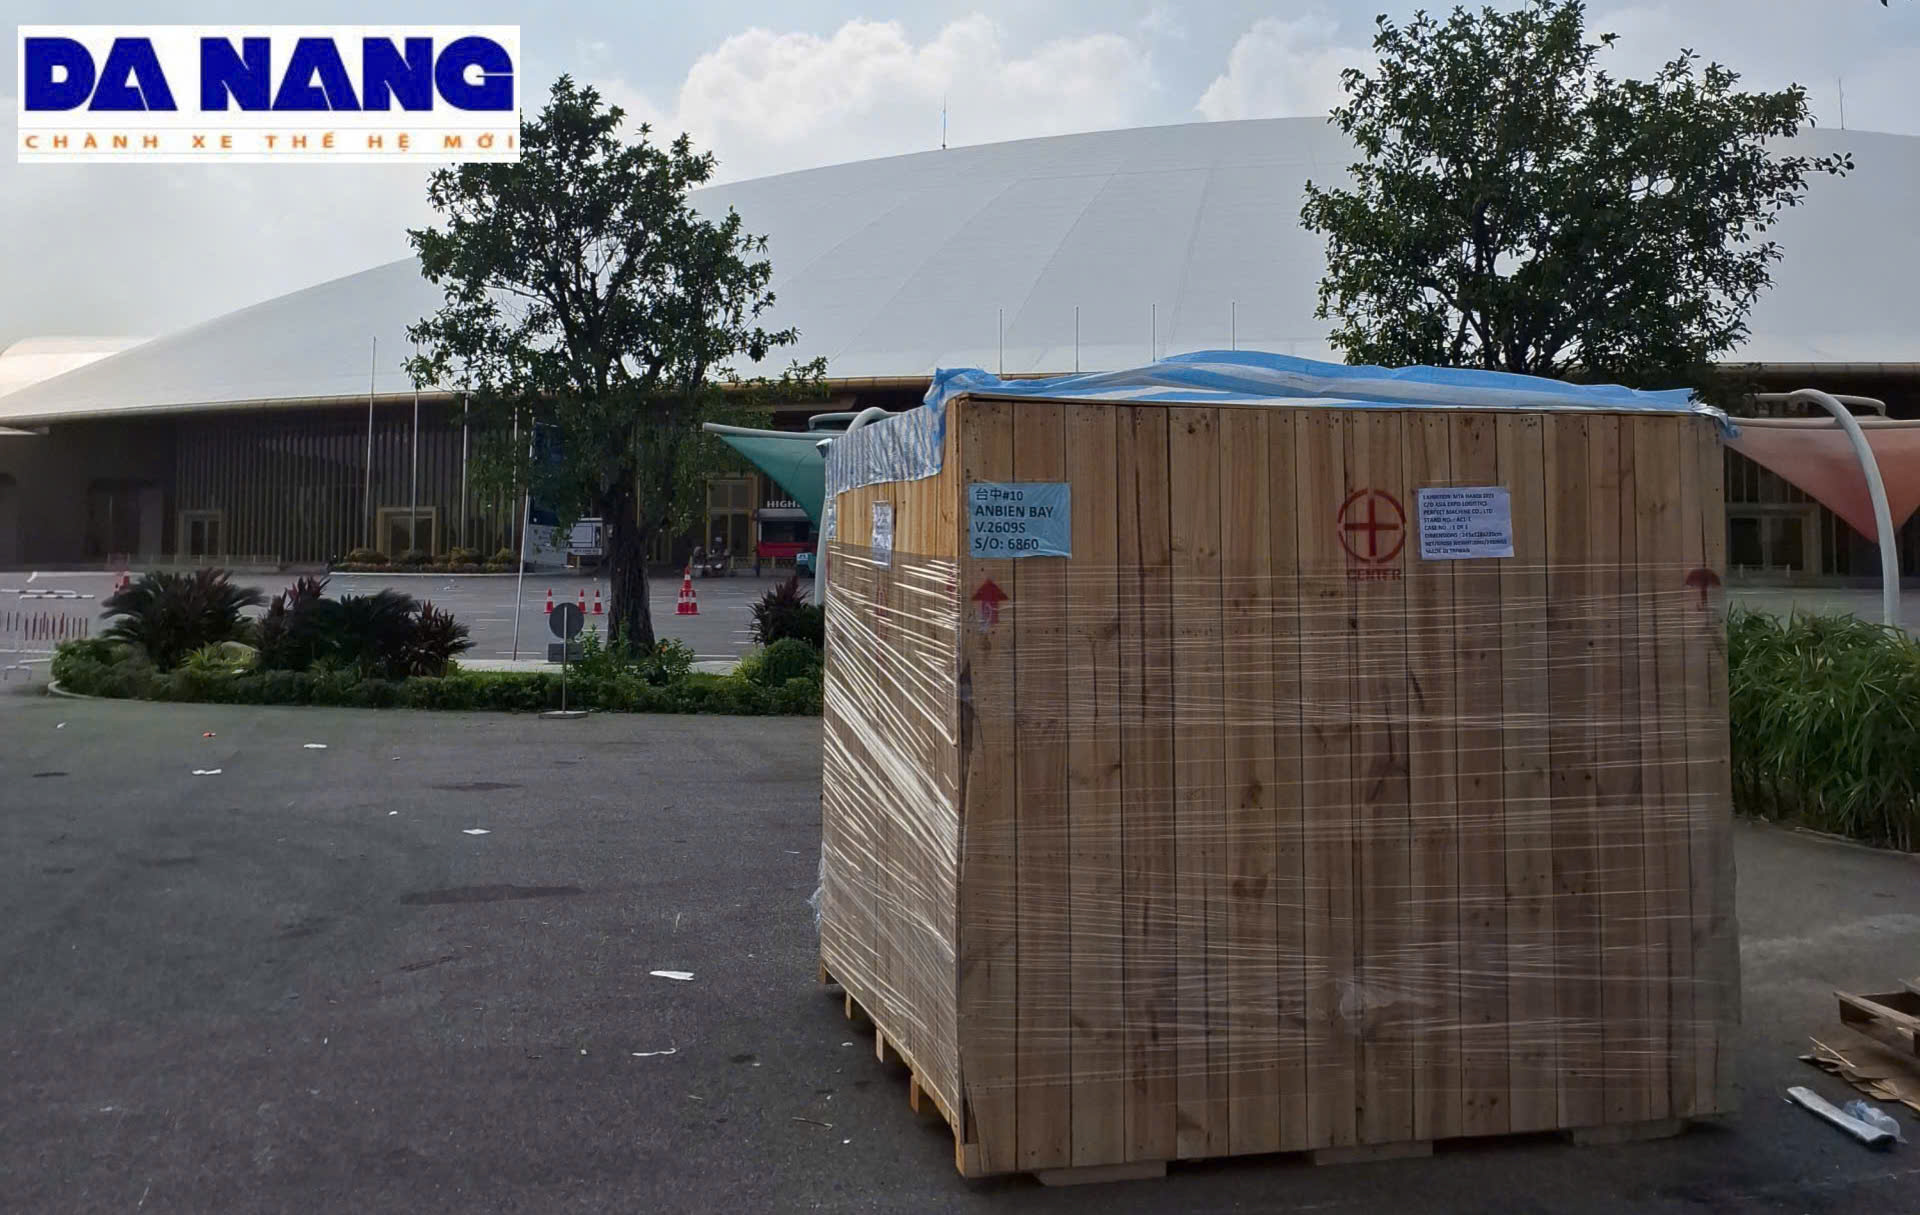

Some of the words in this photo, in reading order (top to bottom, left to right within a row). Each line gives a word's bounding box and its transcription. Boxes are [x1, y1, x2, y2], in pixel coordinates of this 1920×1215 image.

[975, 487, 1024, 501] 台中#10
[975, 505, 1025, 518] ANBIEN
[1029, 506, 1054, 518] BAY
[975, 537, 1004, 551] S/O:
[1007, 538, 1039, 551] 6860
